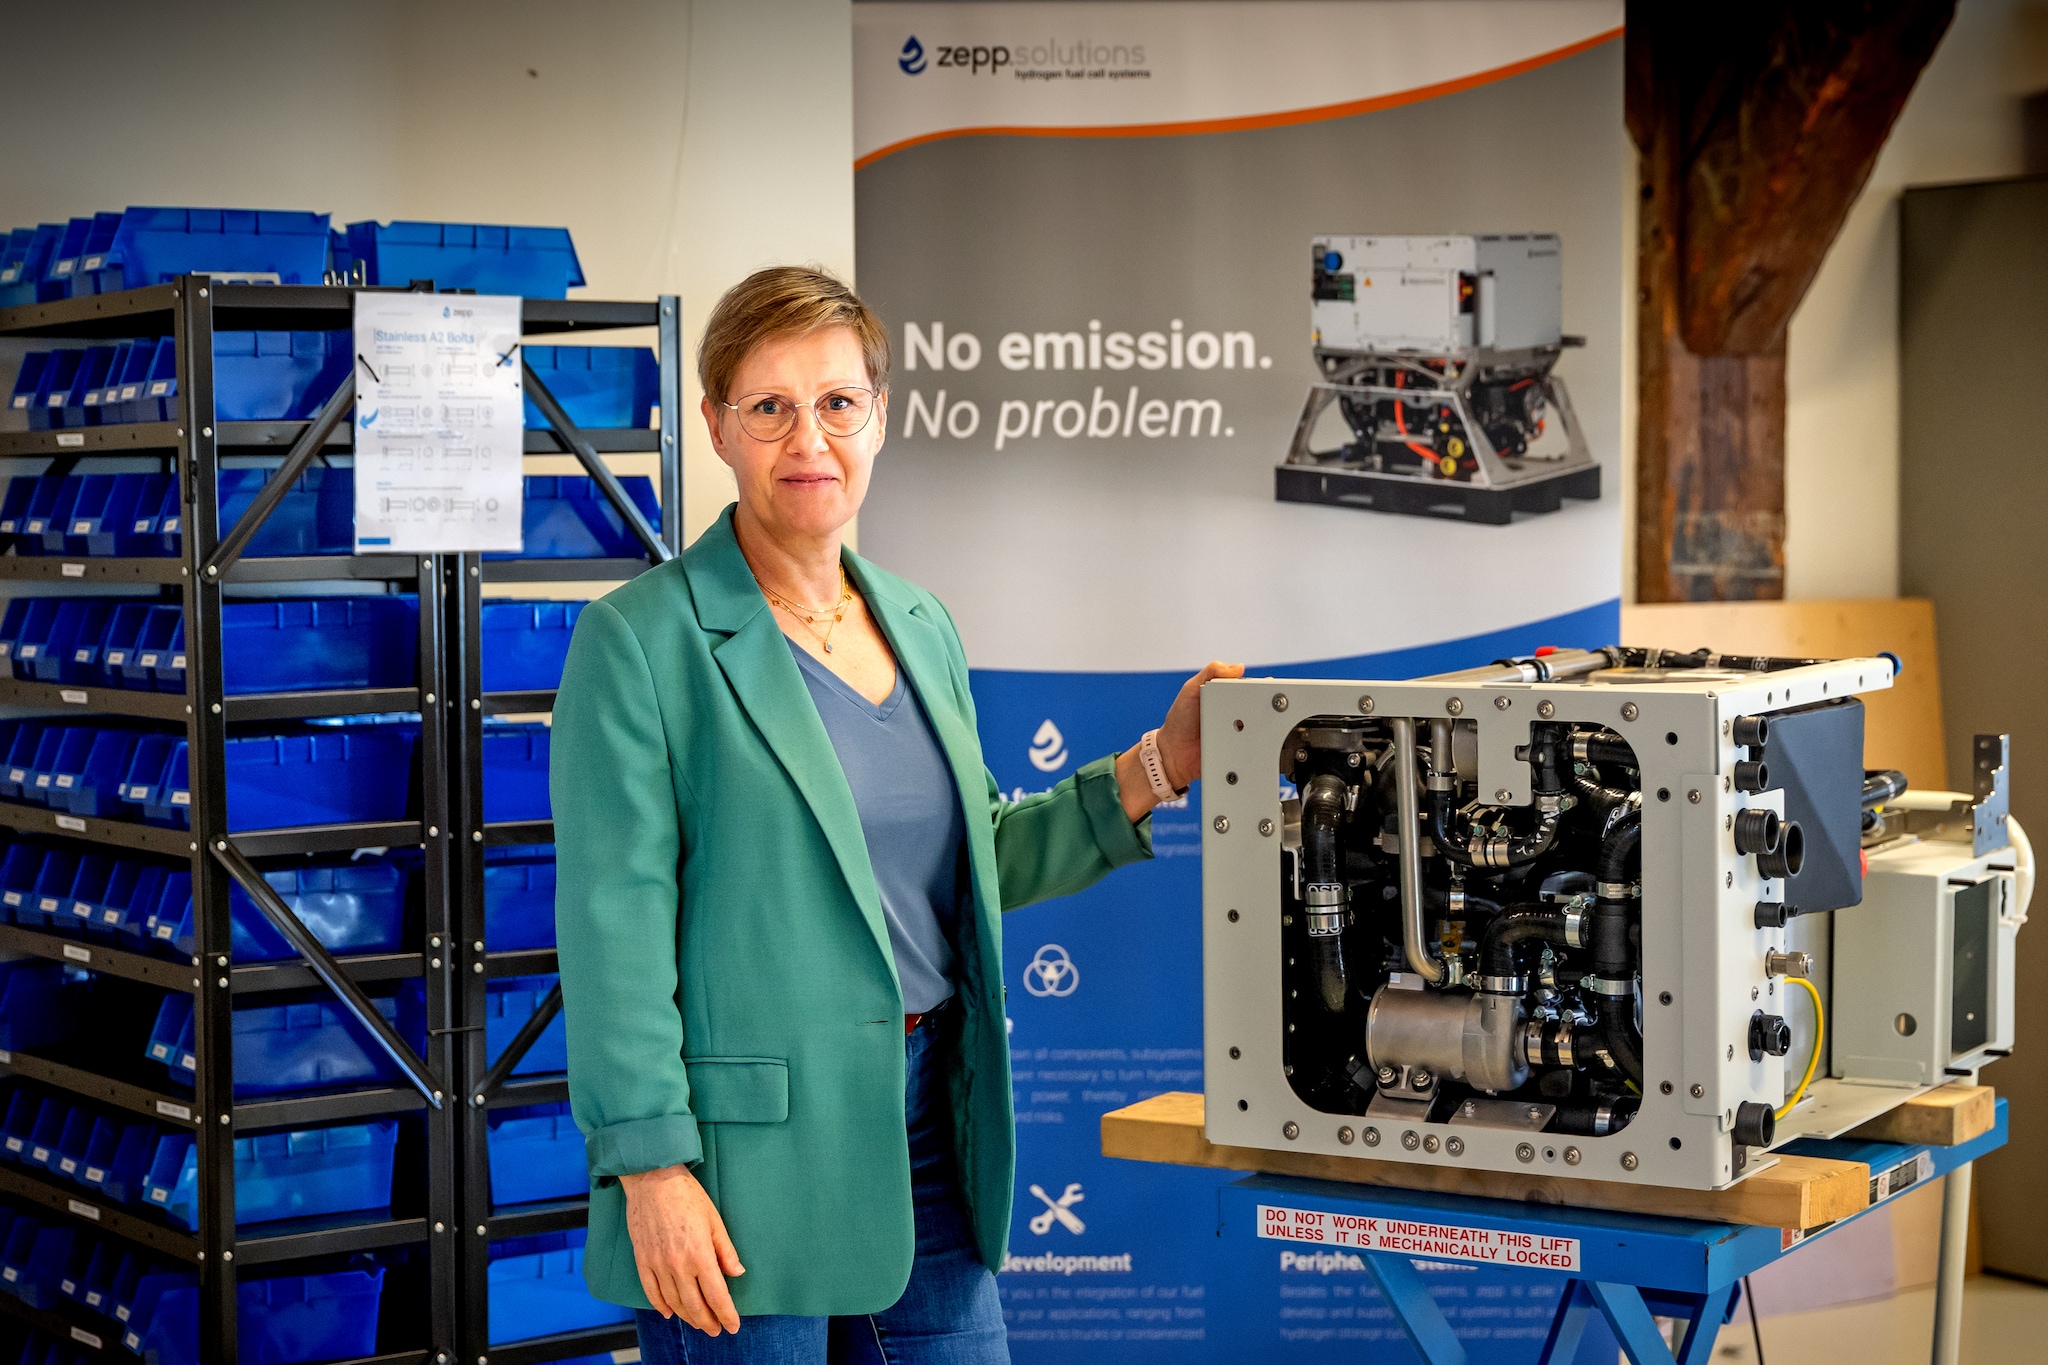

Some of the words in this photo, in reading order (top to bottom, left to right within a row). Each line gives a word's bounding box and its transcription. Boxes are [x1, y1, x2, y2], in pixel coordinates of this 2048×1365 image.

[1014, 69, 1062, 81] hydrogen
[1065, 68, 1085, 79] fuel
[1087, 68, 1105, 79] cell
[1108, 69, 1152, 81] systems
[374, 329, 427, 343] Stainless
[430, 332, 444, 344] A2
[447, 332, 475, 344] Bolts
[903, 321, 982, 371] No
[997, 318, 1273, 371] emission.
[902, 388, 981, 438] No
[994, 385, 1236, 451] problem.
[1265, 1209, 1287, 1222] DO
[1294, 1212, 1325, 1226] NOT
[1332, 1216, 1378, 1231] WORK
[1386, 1221, 1489, 1243] UNDERNEATH
[1497, 1233, 1532, 1248] THIS
[1540, 1237, 1573, 1252] LIFT
[1265, 1224, 1324, 1241] UNLESS
[1336, 1231, 1349, 1243] IT
[1357, 1233, 1371, 1246] IS
[1379, 1236, 1498, 1259] MECHANICALLY
[1507, 1249, 1573, 1268] LOCKED
[1280, 1250, 1367, 1275] Periphe
